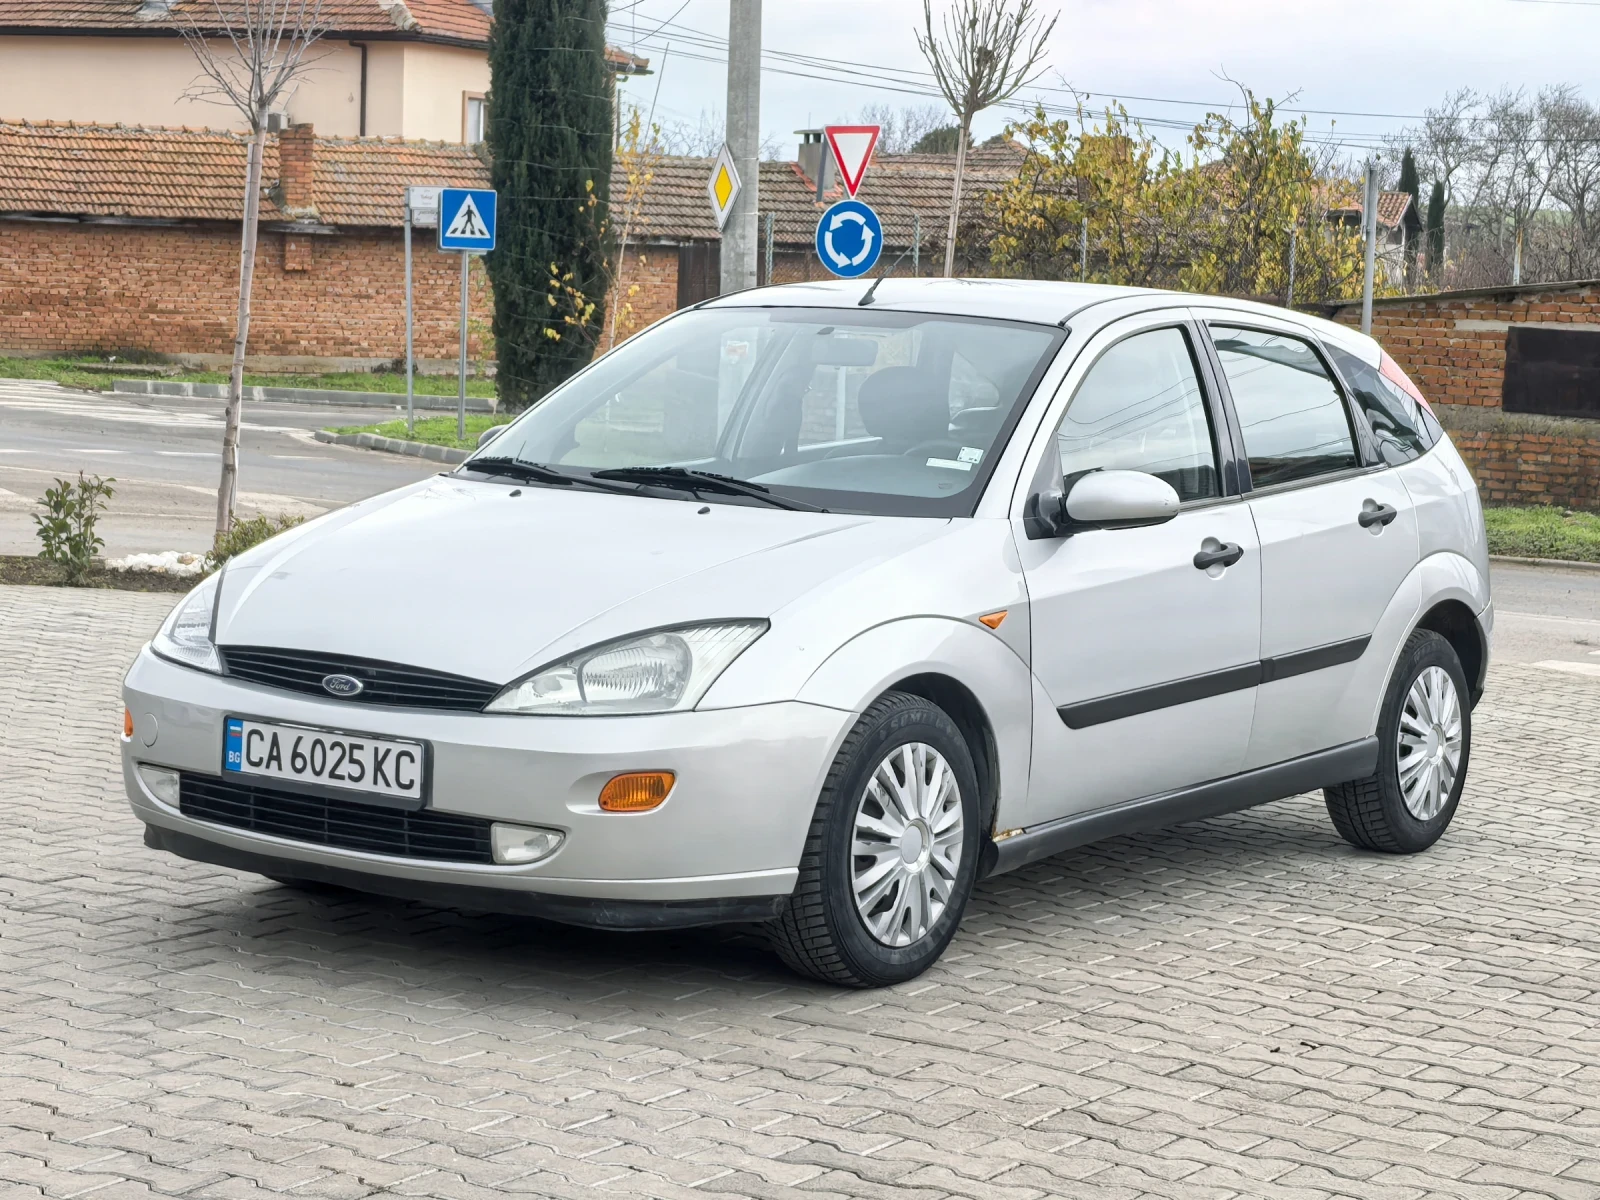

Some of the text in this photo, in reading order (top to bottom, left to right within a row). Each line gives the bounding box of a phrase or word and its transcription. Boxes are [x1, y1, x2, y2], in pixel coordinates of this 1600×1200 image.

[329, 677, 351, 691] Ford
[228, 750, 241, 763] BG
[245, 728, 416, 790] CA 6025 KC
